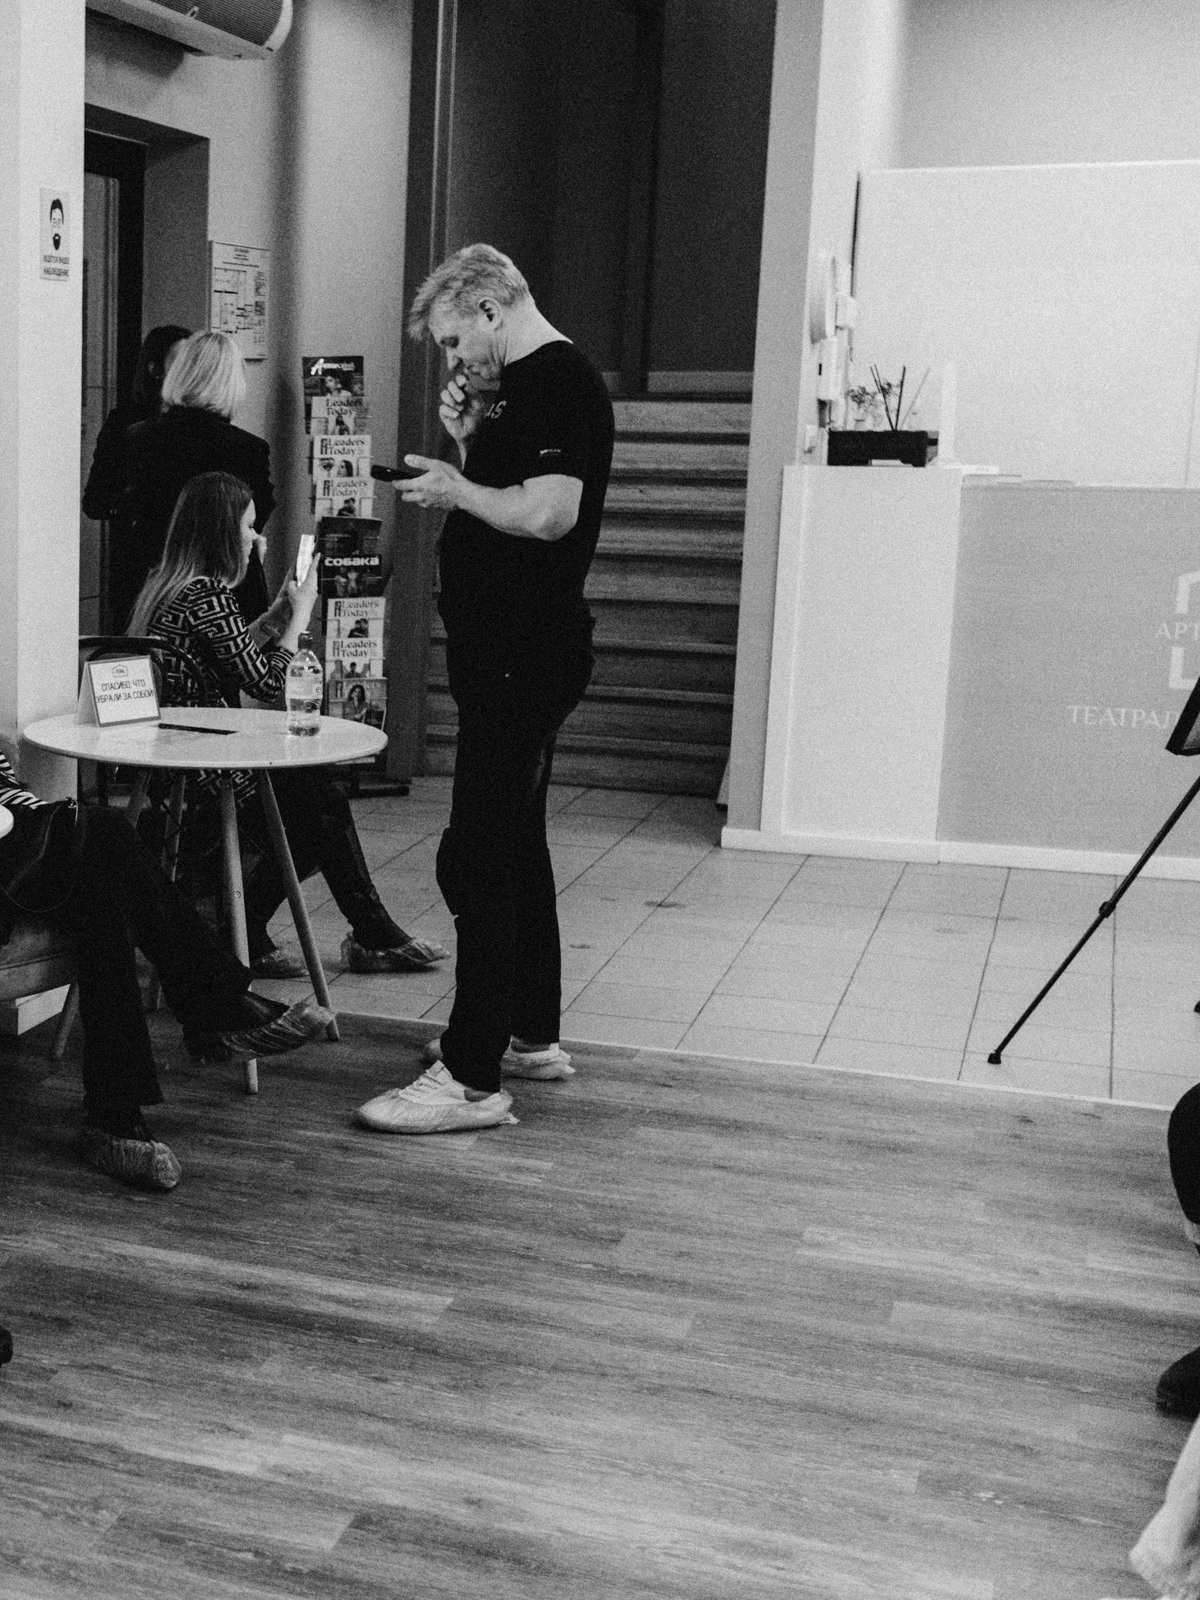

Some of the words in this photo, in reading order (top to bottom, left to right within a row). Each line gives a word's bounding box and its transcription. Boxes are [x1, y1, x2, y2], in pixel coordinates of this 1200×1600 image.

[329, 437, 366, 446] Leaders
[329, 446, 356, 456] Today
[330, 479, 368, 488] Leaders
[331, 488, 358, 498] Today
[341, 600, 379, 609] Leaders
[342, 608, 369, 618] Today
[341, 640, 378, 649] Leaders
[341, 648, 368, 659] Today
[132, 679, 146, 688] ЧТО
[95, 693, 121, 703] УБРАЛИ
[122, 692, 132, 701] ЗА
[132, 688, 153, 699] СОБОЙ
[1066, 704, 1180, 730] ТЕАТРАЛ
